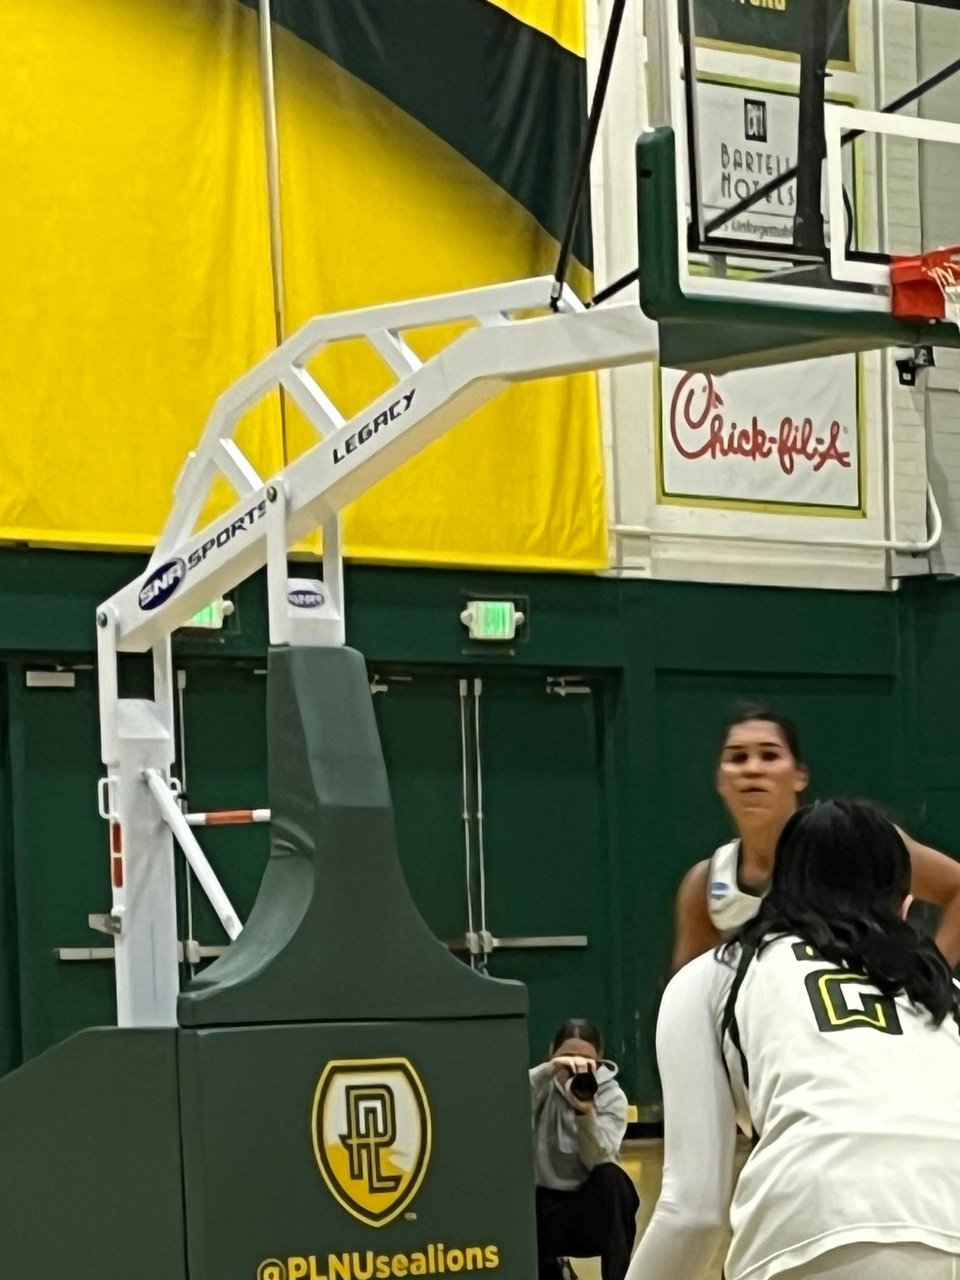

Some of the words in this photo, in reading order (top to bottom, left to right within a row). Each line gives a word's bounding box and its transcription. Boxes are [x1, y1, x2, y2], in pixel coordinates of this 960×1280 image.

[332, 388, 416, 464] LEGACY
[670, 371, 851, 475] Chick-fil-A
[187, 499, 267, 571] SPORTS
